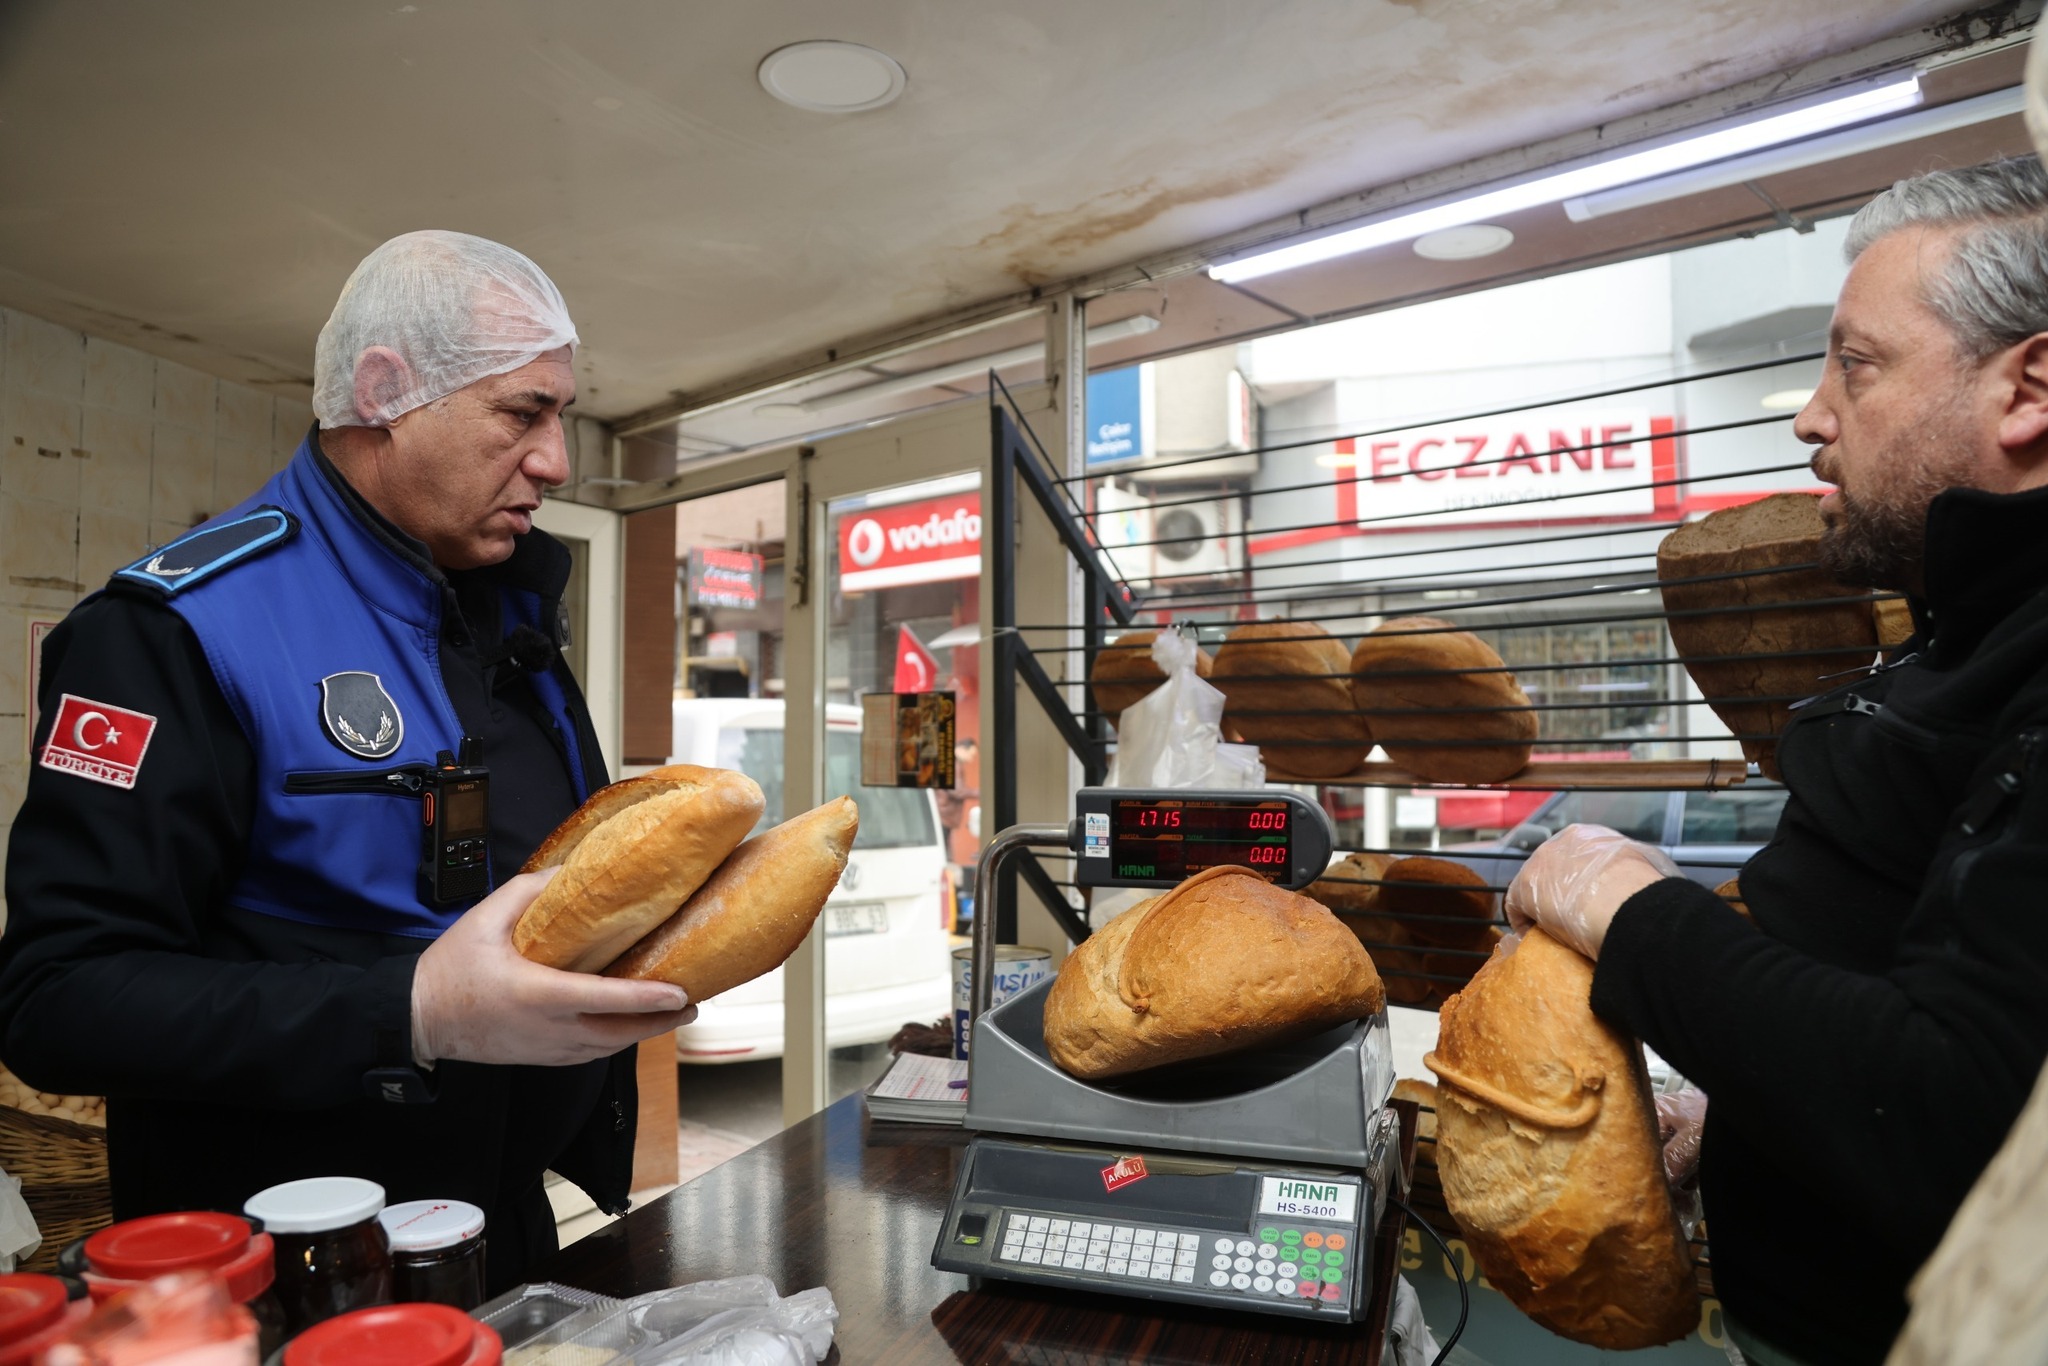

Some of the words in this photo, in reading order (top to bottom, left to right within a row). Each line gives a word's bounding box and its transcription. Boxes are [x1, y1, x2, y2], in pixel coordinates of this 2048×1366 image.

[1371, 424, 1635, 484] ECZANE
[48, 752, 132, 784] TÜRKİYE
[457, 783, 475, 792] Hytera
[1140, 811, 1180, 827] 1.715
[1249, 813, 1286, 829] 0.00
[1250, 847, 1287, 863] 0.00
[1119, 865, 1155, 877] HANA
[1108, 1161, 1141, 1183] AKÜLÜ
[1278, 1181, 1338, 1202] HANA
[1277, 1202, 1337, 1217] HS-5400
